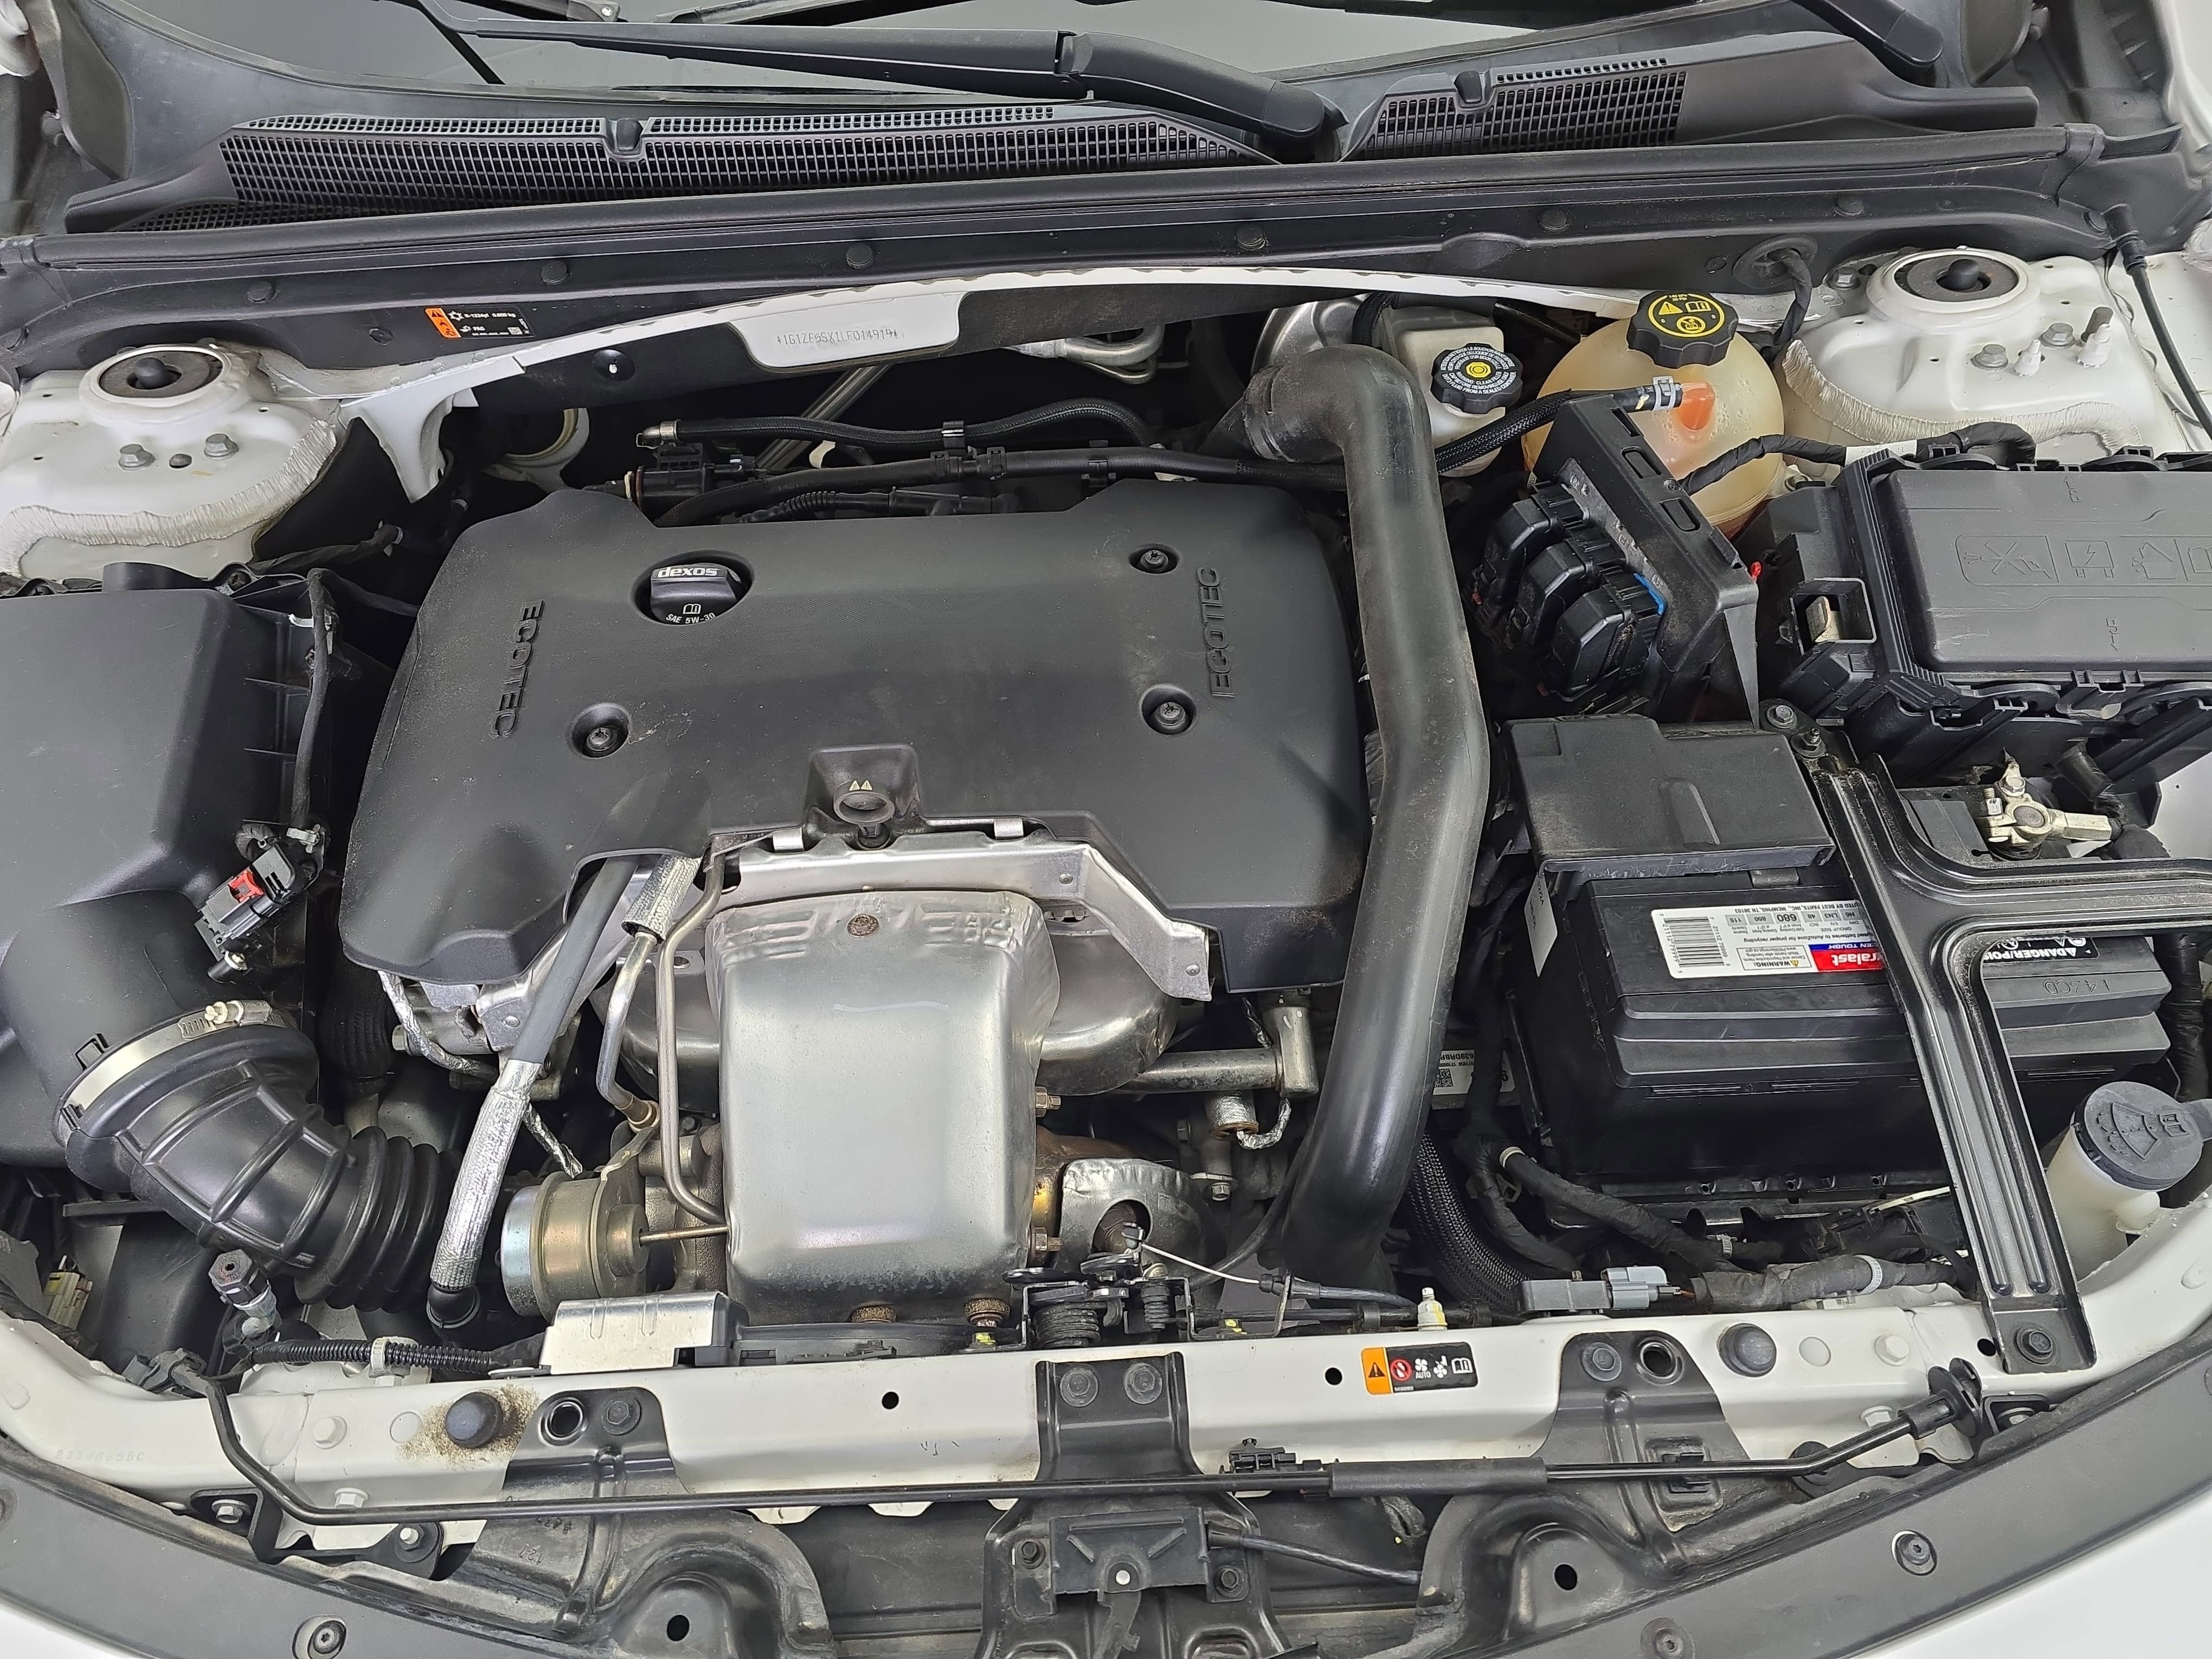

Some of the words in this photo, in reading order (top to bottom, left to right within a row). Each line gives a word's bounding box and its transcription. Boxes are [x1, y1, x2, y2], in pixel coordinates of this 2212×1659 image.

[658, 567, 718, 578] dexos
[665, 613, 681, 623] SAE
[685, 612, 716, 624] 5W-30
[1197, 567, 1234, 697] ECOTEC
[491, 600, 544, 737] ECOTEC
[1777, 914, 1797, 922] 680
[1831, 953, 1880, 966] ralast
[1983, 948, 2066, 960] DANGER/POIS
